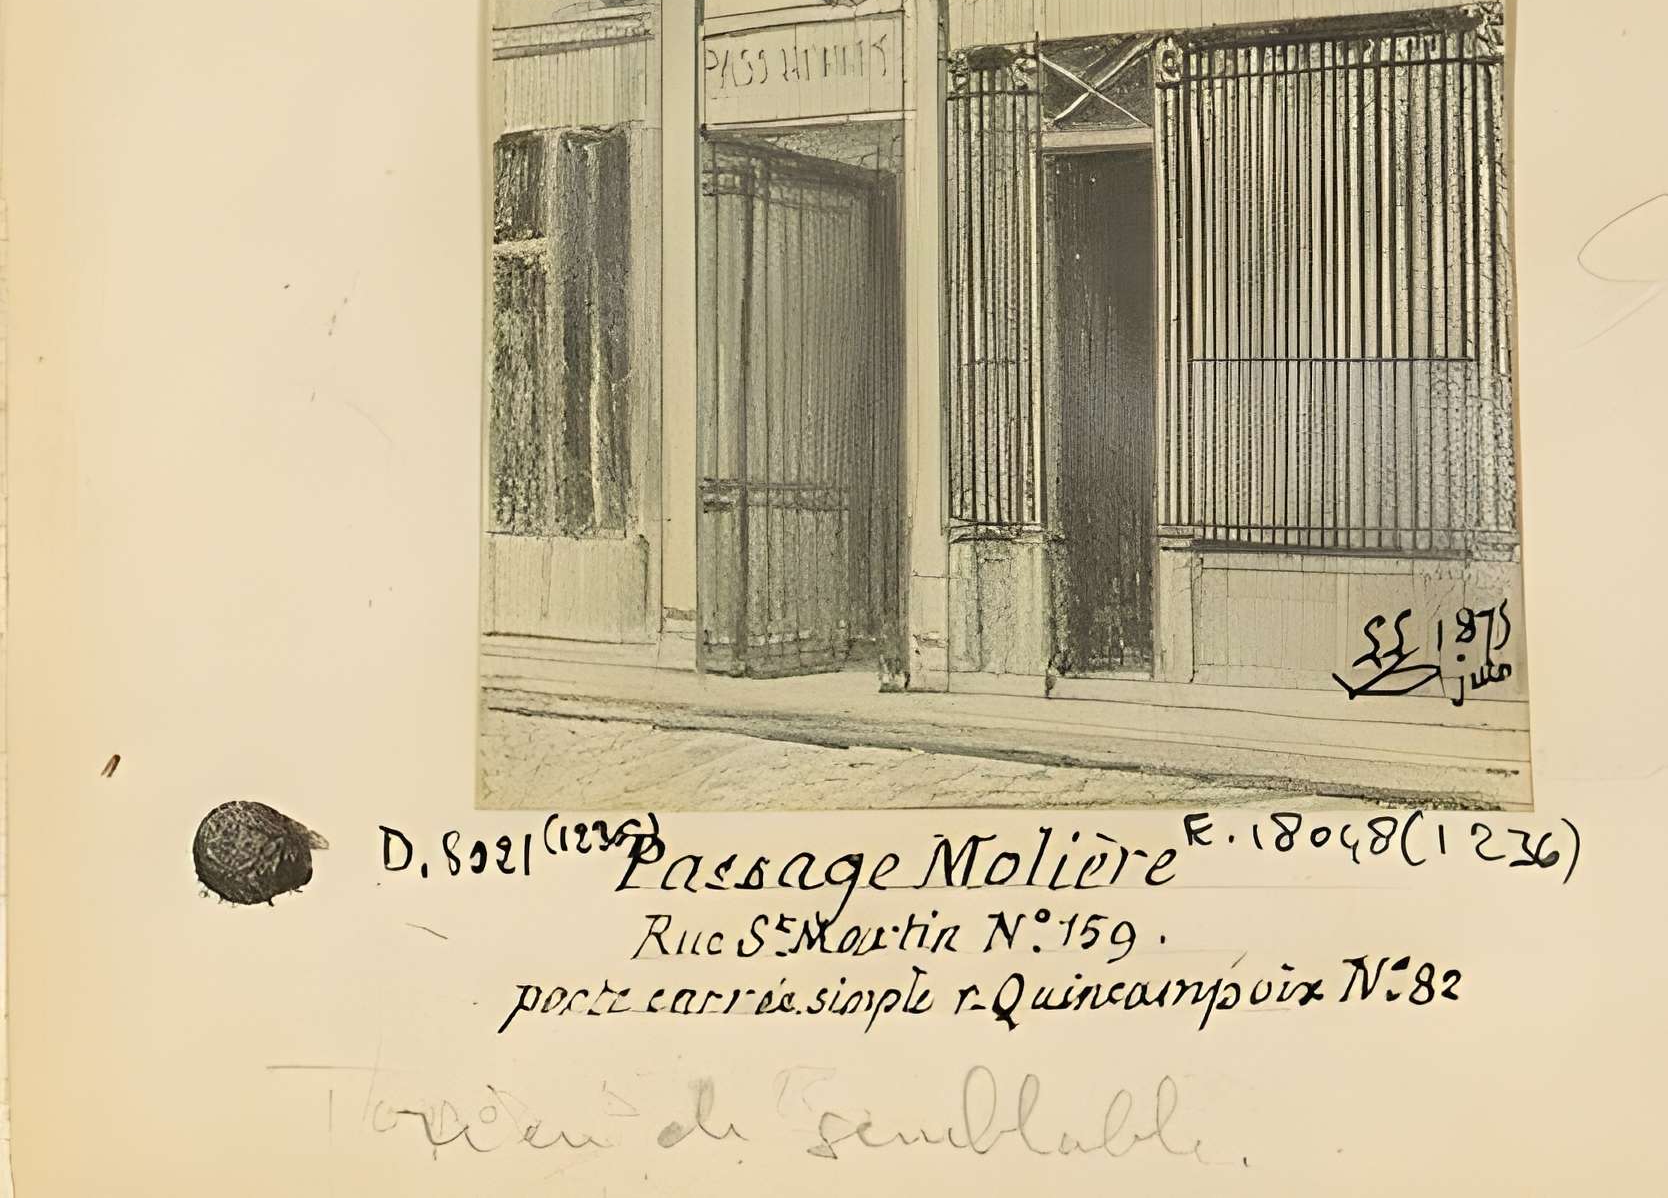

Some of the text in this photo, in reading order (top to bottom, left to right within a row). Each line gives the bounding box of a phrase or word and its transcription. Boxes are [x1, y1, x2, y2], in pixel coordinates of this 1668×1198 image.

[614, 826, 1178, 927] Passage Molière
[630, 914, 724, 960] Rue
[788, 909, 961, 956] Martin
[497, 979, 632, 1033] porte
[806, 965, 933, 1033] simple
[991, 962, 1324, 1032] Quincampoix
[1408, 961, 1462, 1005] 82
